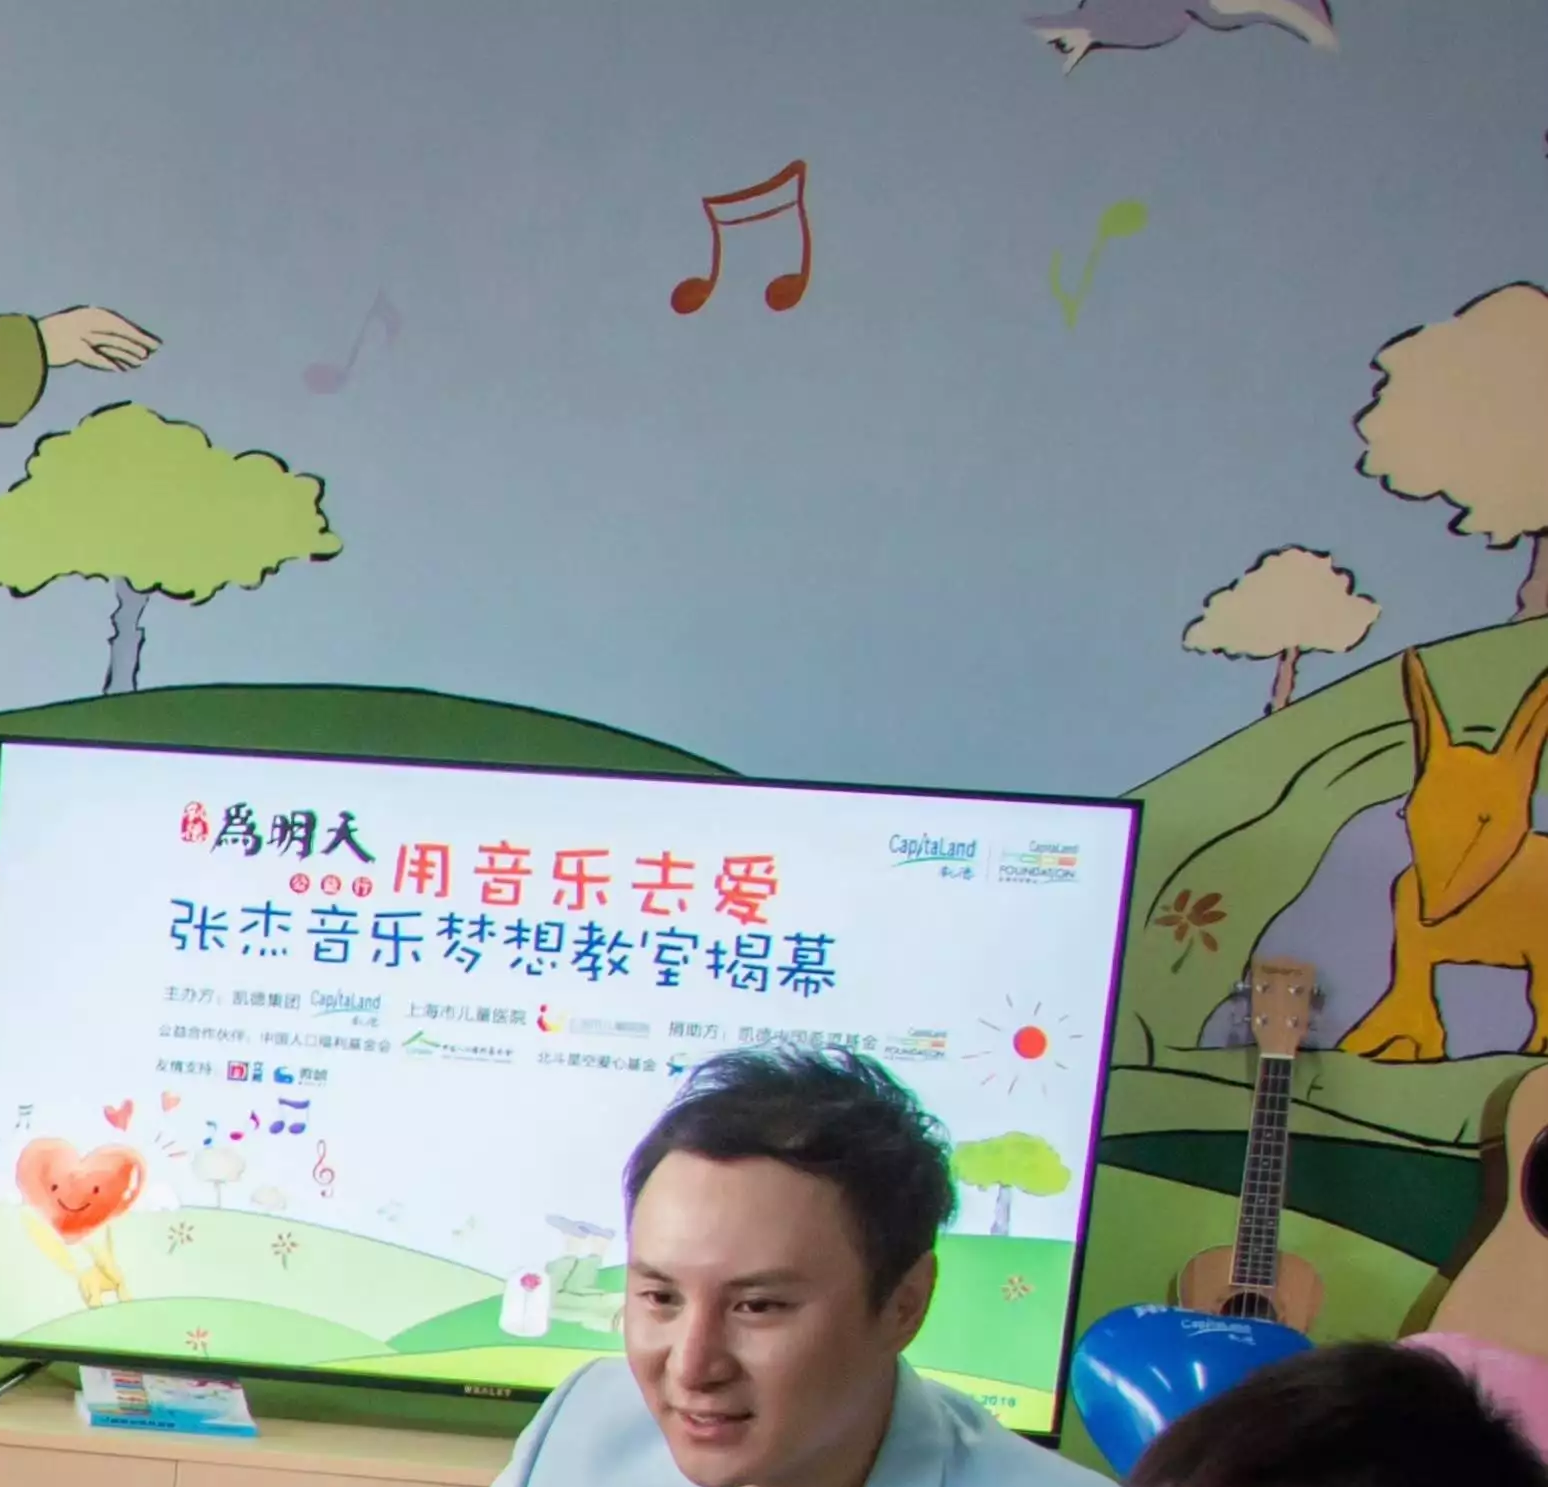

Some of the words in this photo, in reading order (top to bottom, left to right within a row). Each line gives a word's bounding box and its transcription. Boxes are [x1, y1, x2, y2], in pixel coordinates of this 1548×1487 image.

[392, 841, 779, 926] 用音乐去爱
[169, 898, 838, 998] 张杰音乐梦想教室揭幕
